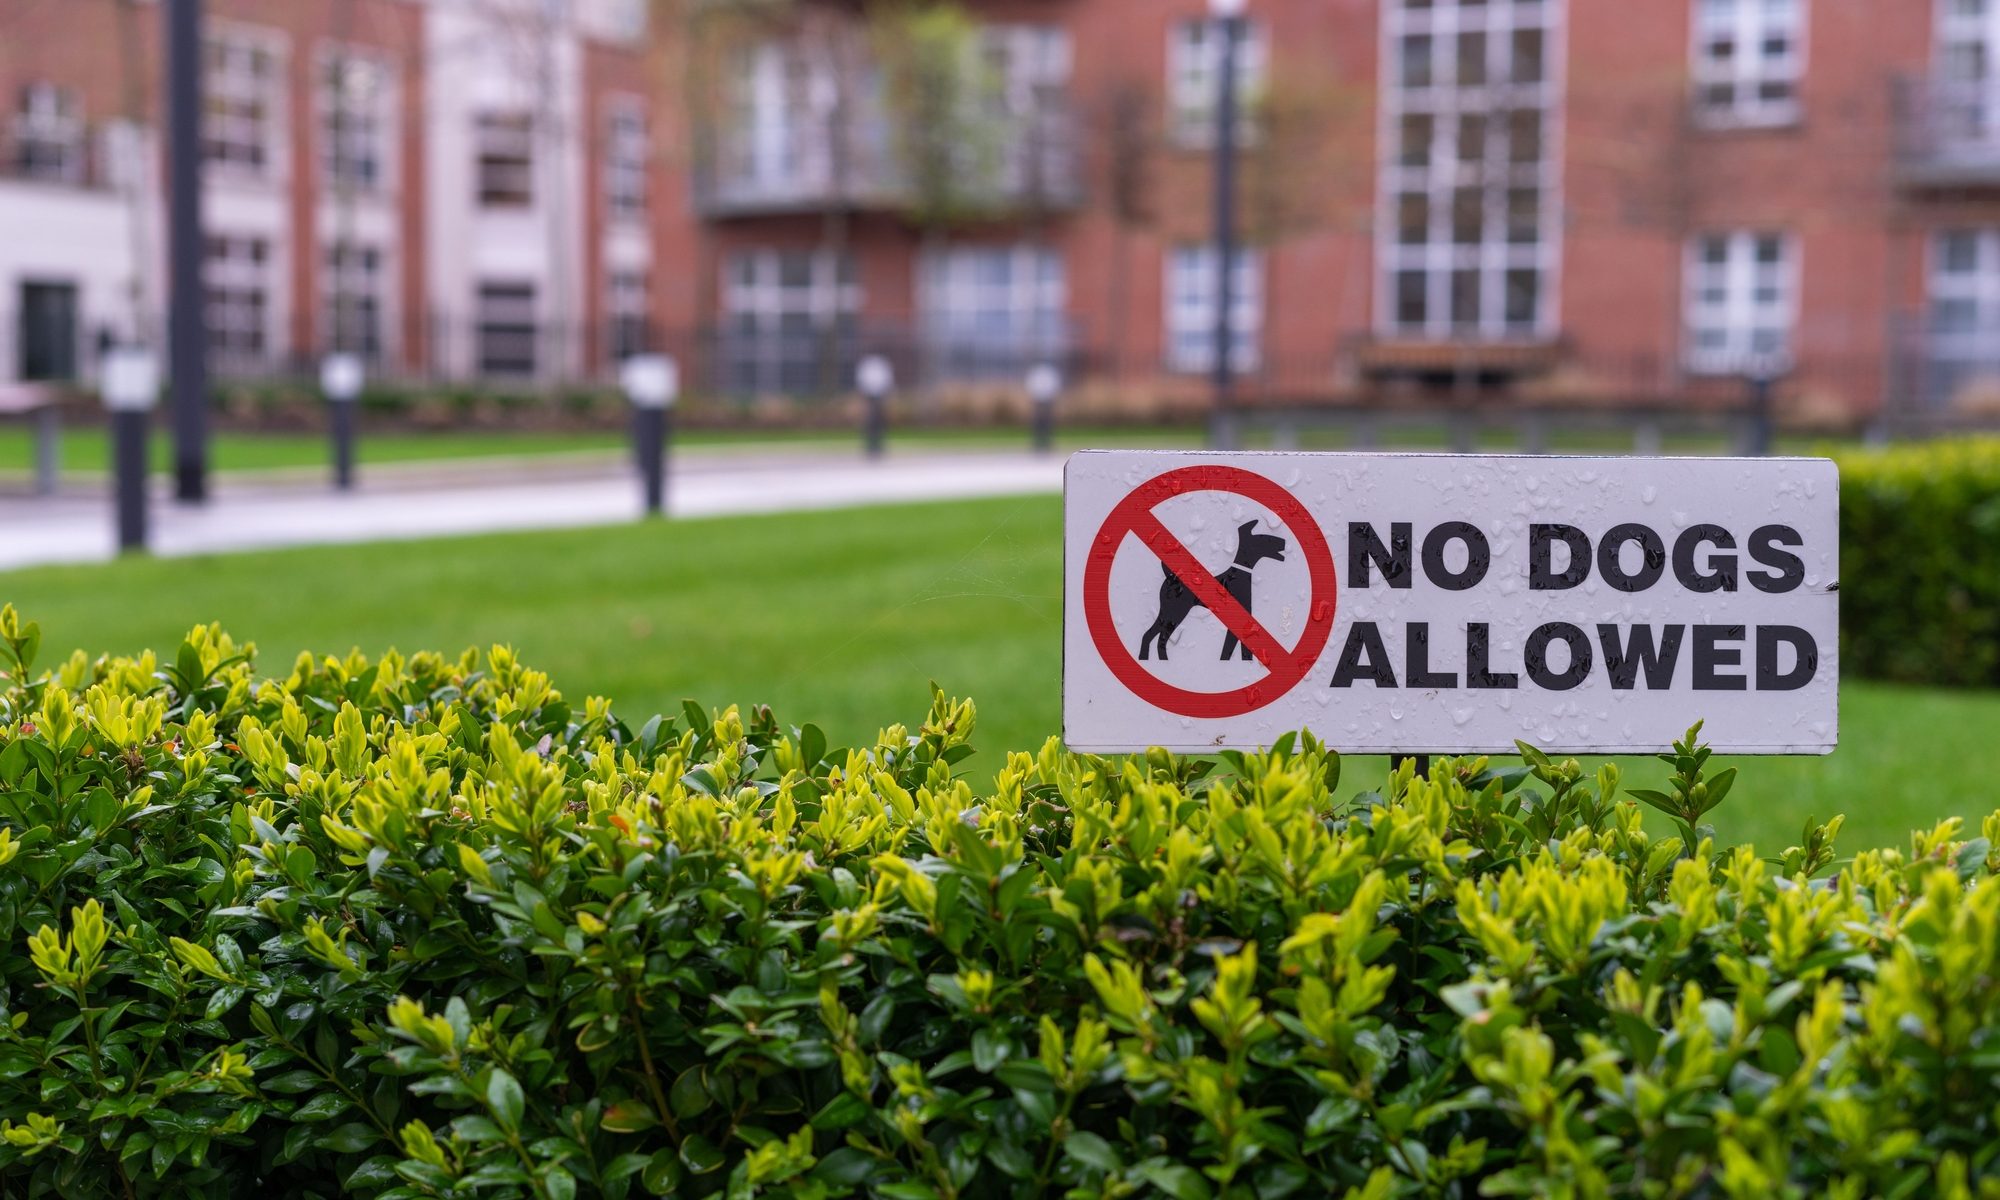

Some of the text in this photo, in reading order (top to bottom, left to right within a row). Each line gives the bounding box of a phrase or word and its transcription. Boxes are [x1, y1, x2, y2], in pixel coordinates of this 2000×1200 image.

[1348, 521, 1805, 593] NO DOGS
[1330, 621, 1818, 691] ALLOWED
